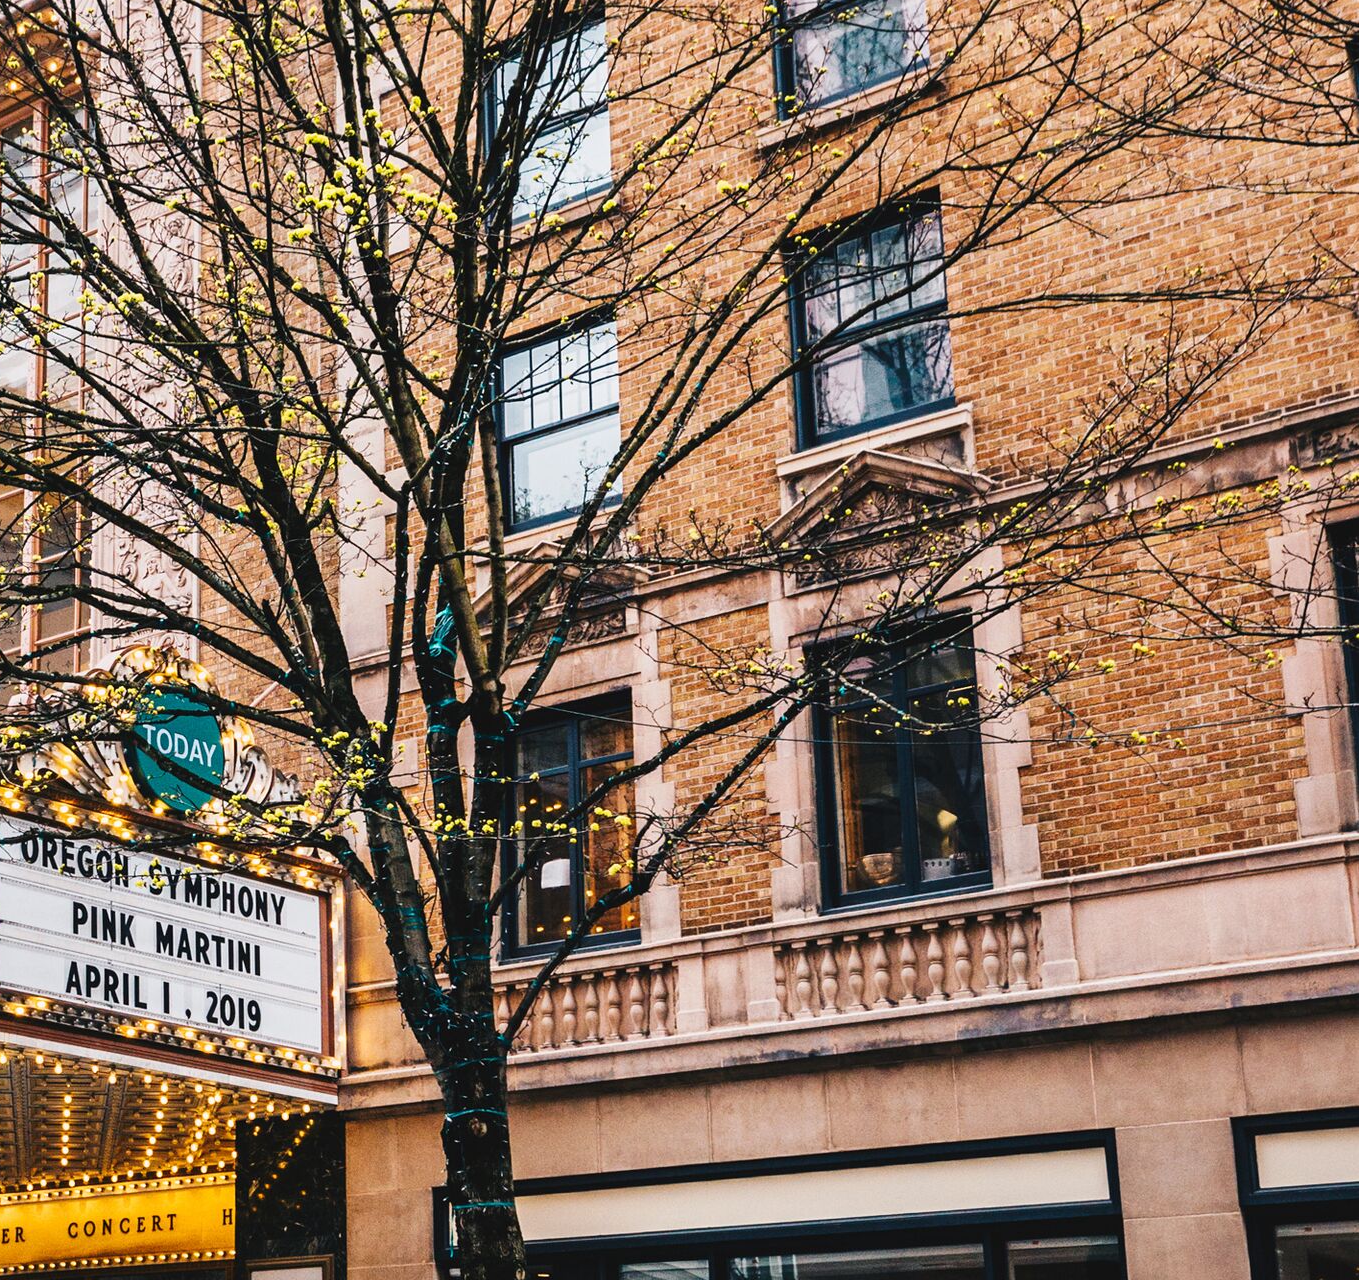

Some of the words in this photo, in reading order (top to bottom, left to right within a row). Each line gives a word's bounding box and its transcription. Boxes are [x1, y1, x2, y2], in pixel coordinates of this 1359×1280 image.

[144, 723, 217, 768] TODAY
[21, 835, 129, 889] OREGON
[149, 862, 286, 926] SYMPHONY
[73, 901, 136, 948] PINK
[156, 921, 261, 976] MARTINI
[65, 961, 148, 1010] APRIL
[206, 990, 262, 1032] 2019
[67, 1213, 177, 1239] CONCERT
